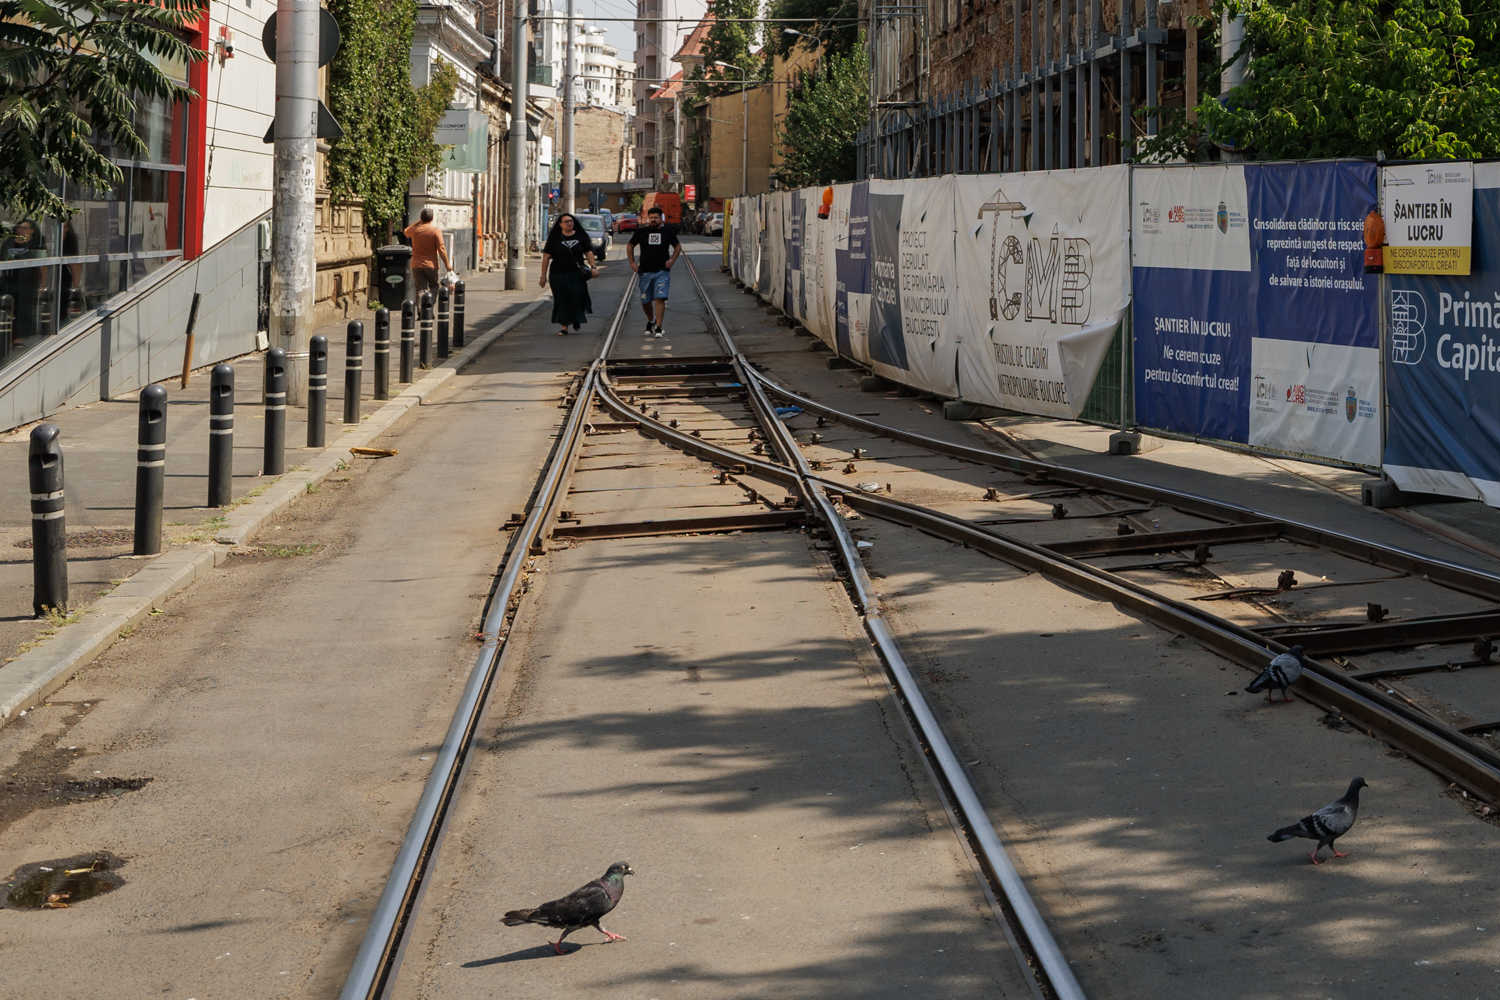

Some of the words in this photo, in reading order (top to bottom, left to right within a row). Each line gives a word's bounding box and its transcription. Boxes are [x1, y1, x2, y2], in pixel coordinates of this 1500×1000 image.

[1440, 198, 1452, 219] ÎN
[1253, 218, 1297, 230] Consolidarea
[1298, 218, 1328, 230] clădirilor
[1328, 220, 1336, 230] cu
[1337, 219, 1351, 230] risc
[1351, 218, 1365, 231] seis
[1408, 225, 1443, 241] LUCRU
[902, 231, 927, 248] PROIECT
[1267, 237, 1301, 252] reprezintă
[1302, 240, 1312, 249] un
[1312, 239, 1327, 253] gest
[1328, 237, 1336, 250] de
[1337, 239, 1364, 253] respect
[902, 253, 929, 270] DERULAT
[1390, 249, 1398, 257] NE
[1398, 249, 1417, 257] CEREM
[1418, 249, 1437, 258] SCUZE
[1437, 249, 1461, 258] PENTRU
[1286, 255, 1300, 271] față
[1301, 256, 1309, 268] de
[1309, 256, 1339, 270] locuitori
[1340, 257, 1346, 273] și
[1393, 260, 1435, 270] DISCONFORTUL
[1436, 260, 1457, 270] CREAT!
[902, 274, 911, 291] DE
[911, 272, 946, 293] PRIMĂRIA
[1269, 273, 1279, 286] de
[1279, 274, 1302, 287] salvare
[1303, 278, 1309, 287] a
[1309, 275, 1333, 289] istoriei
[1334, 277, 1364, 293] orașului.
[903, 296, 950, 316] MUNICIPIULUI
[1154, 316, 1189, 335] ȘANTIER
[1190, 317, 1200, 335] ÎN
[1201, 320, 1231, 338] LUCRU!
[993, 342, 1015, 366] TRUSTUL
[1016, 345, 1024, 367] DE
[1025, 346, 1049, 370] CLADIRI
[1163, 345, 1174, 359] Ne
[1175, 348, 1199, 363] cerem
[1199, 352, 1221, 365] scuze
[1145, 368, 1171, 383] pentru
[1171, 368, 1217, 389] disconfortul
[1218, 377, 1240, 391] creat!
